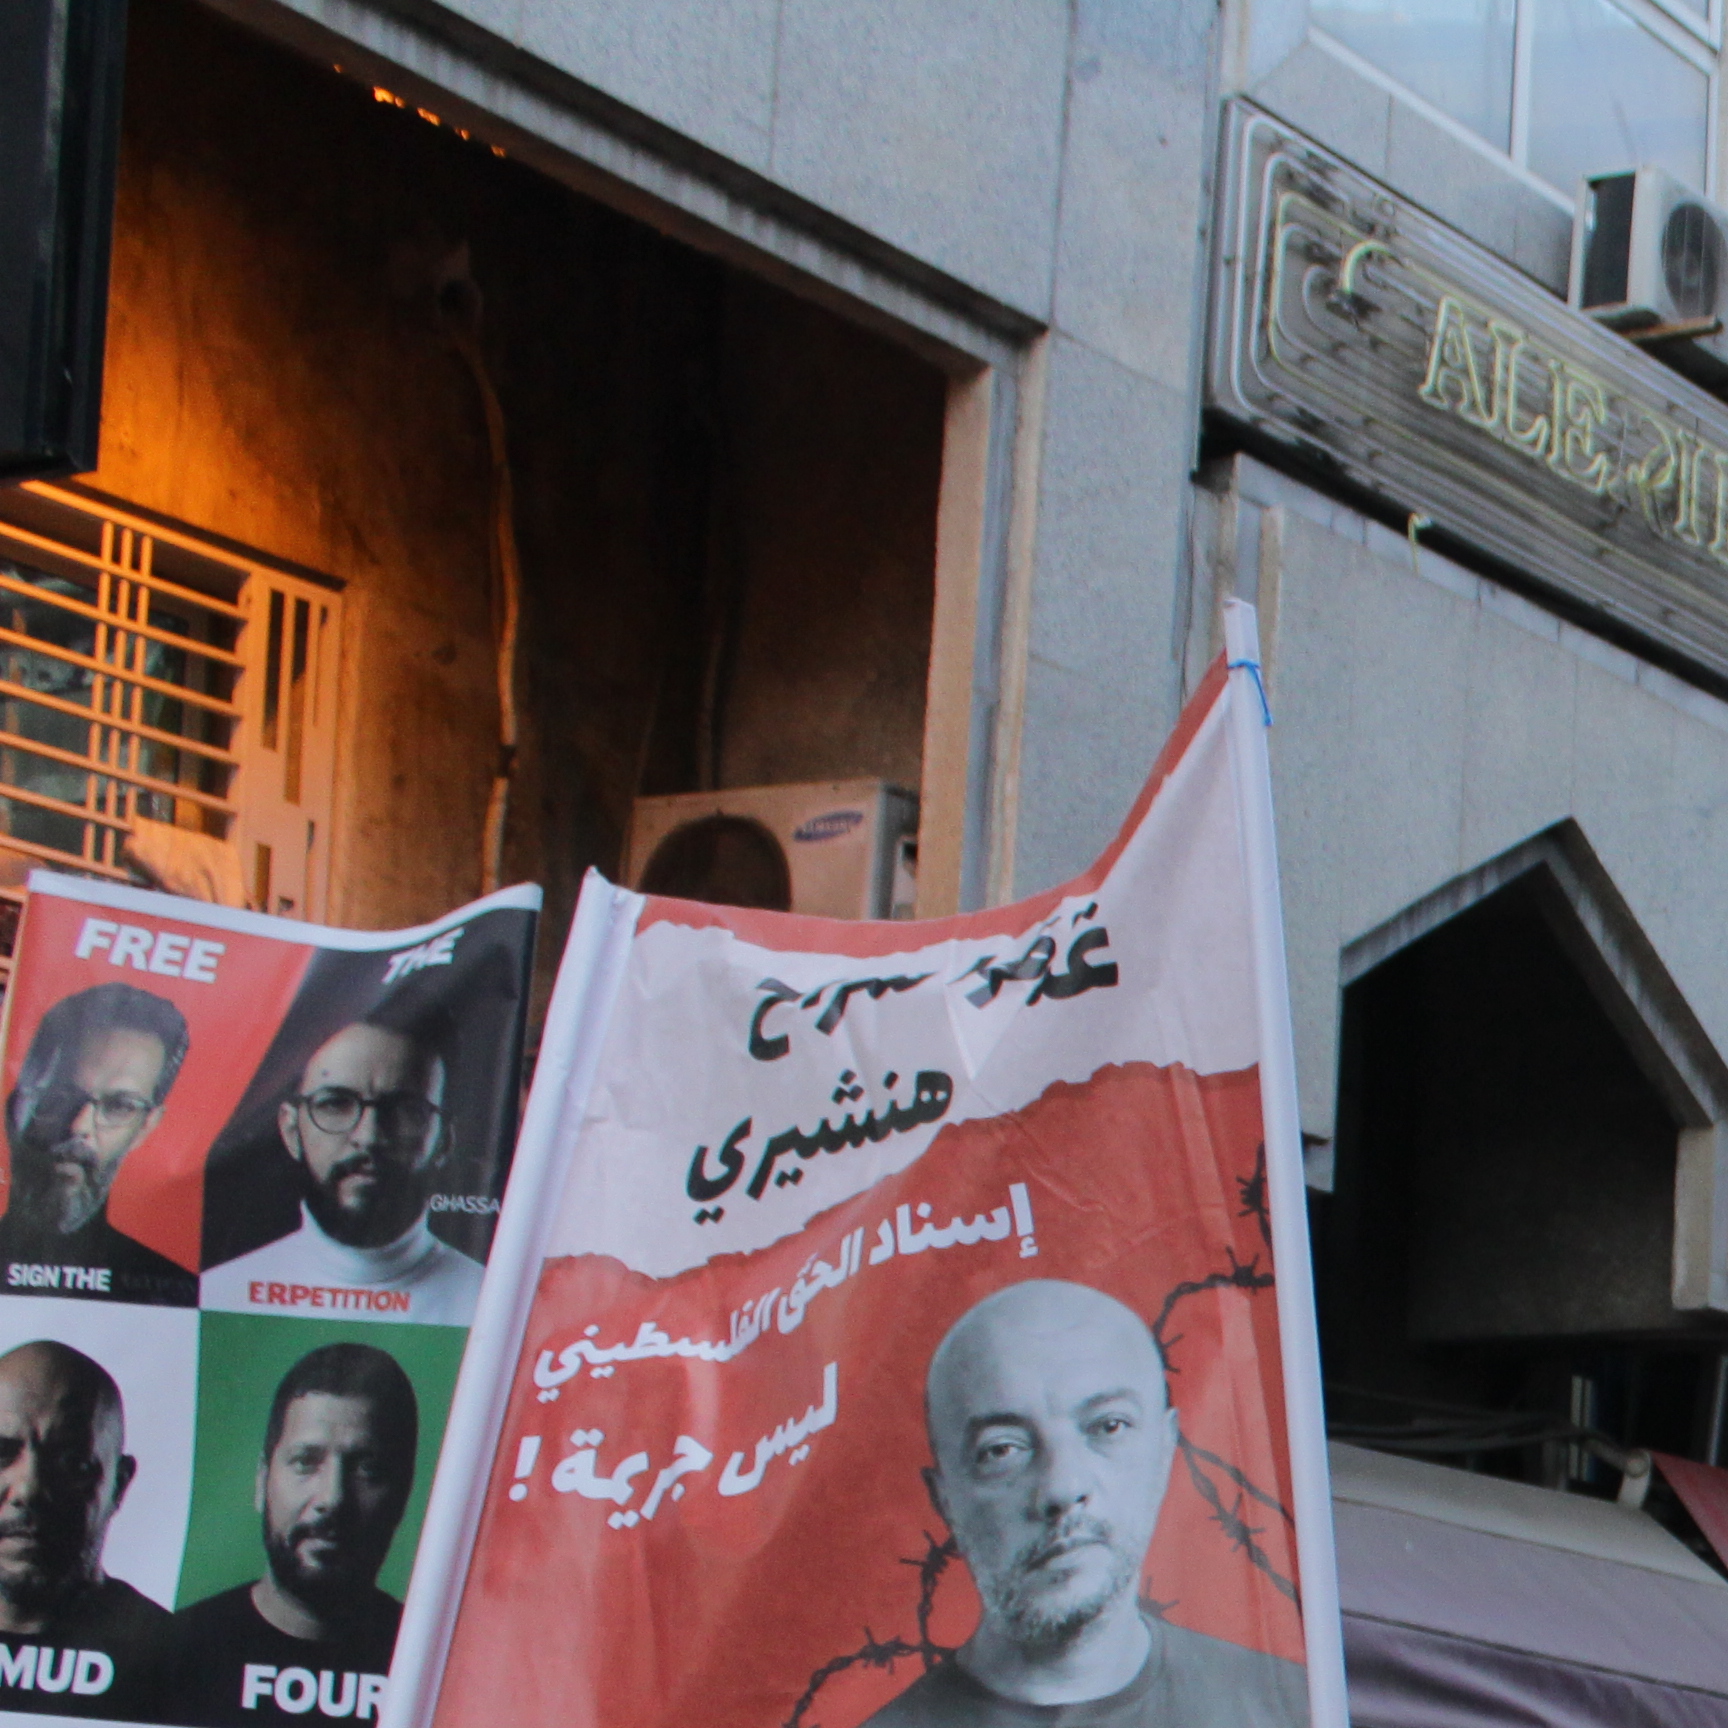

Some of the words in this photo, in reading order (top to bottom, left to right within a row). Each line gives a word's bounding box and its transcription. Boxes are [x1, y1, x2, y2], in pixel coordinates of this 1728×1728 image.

[75, 917, 226, 984] FREE
[382, 928, 464, 985] THE
[686, 1069, 954, 1226] هنشيري
[868, 1181, 1039, 1266] إسناد
[8, 1263, 62, 1288] SIGN
[62, 1266, 112, 1292] THE
[248, 1281, 410, 1313] ERPETITION
[533, 1287, 782, 1402] الفلسطيني
[717, 1361, 838, 1498] ليس
[551, 1429, 713, 1530] جريمة
